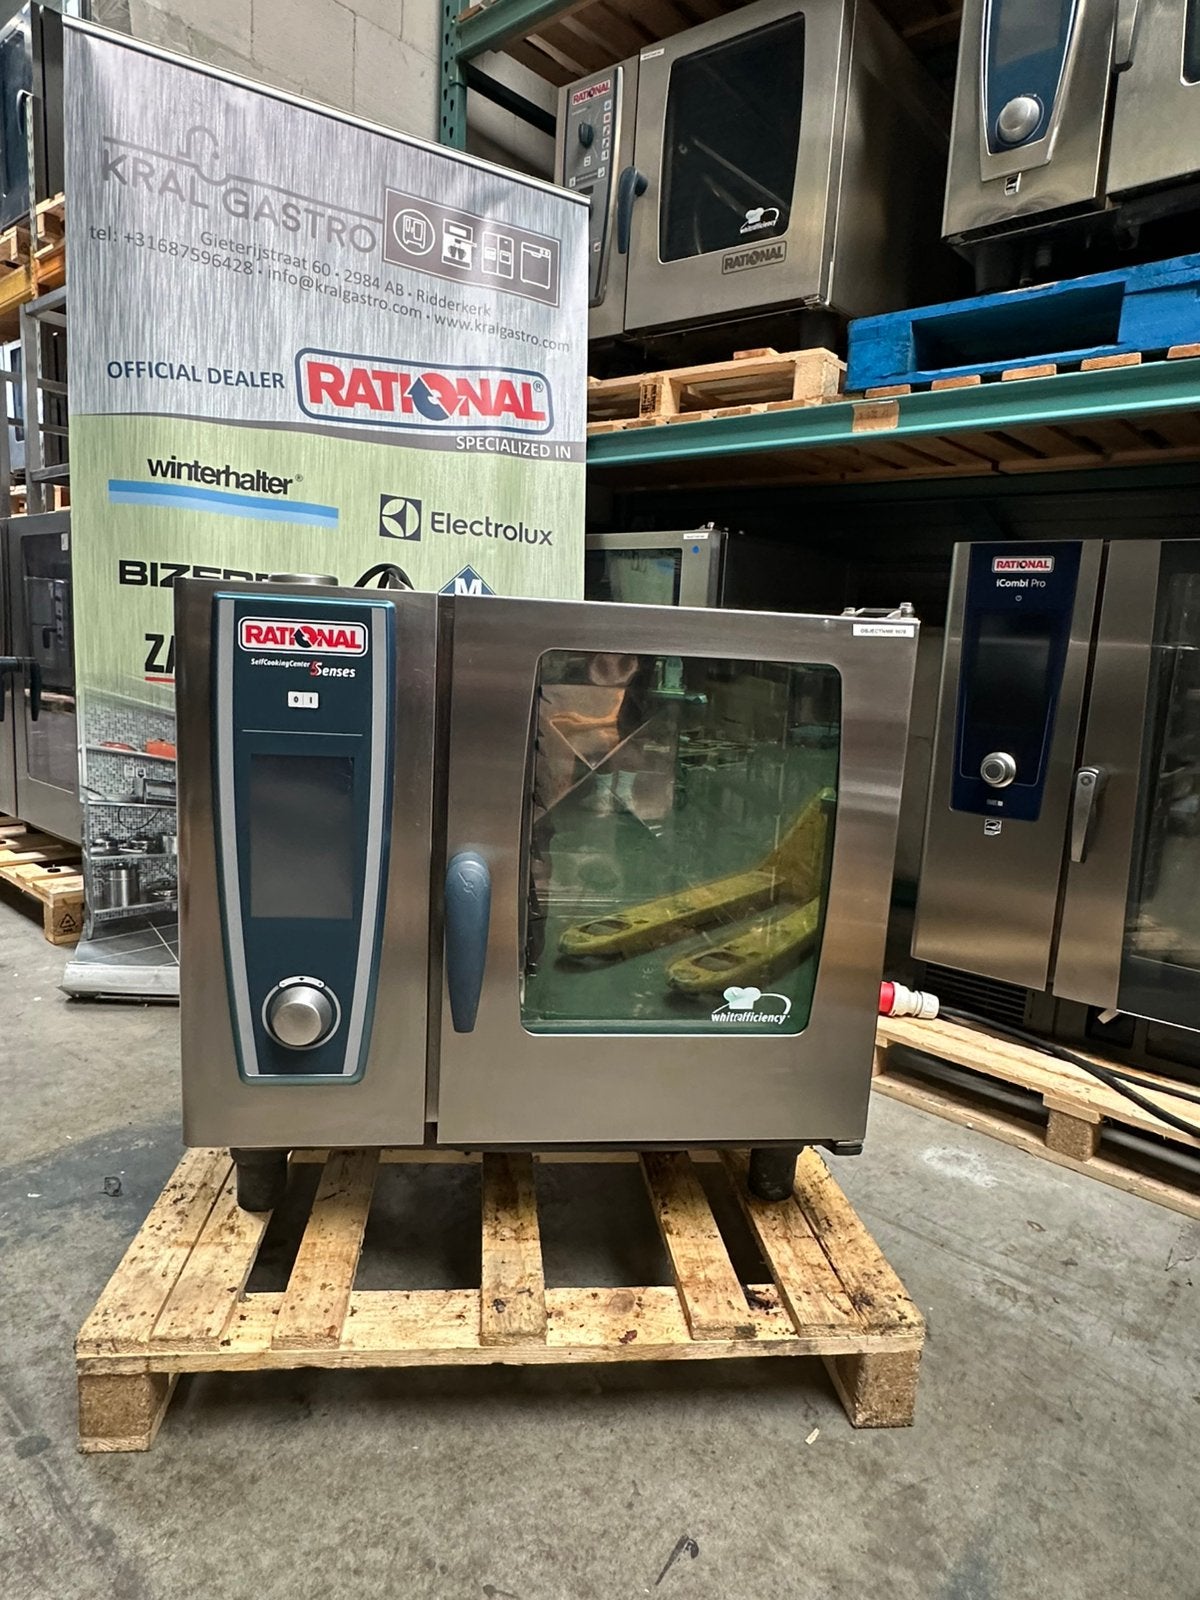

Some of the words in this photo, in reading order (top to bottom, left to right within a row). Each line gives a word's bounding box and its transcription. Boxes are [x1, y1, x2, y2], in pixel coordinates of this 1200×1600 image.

[103, 150, 209, 209] KRAL
[222, 188, 376, 253] GASTRO
[725, 246, 784, 271] RATIONAL
[200, 231, 308, 271] Gieterijstraat
[312, 262, 331, 277] 60
[344, 269, 380, 290] 2984
[384, 281, 404, 297] AB
[416, 289, 491, 317] Ridderkerk
[90, 224, 117, 243] tel:
[268, 265, 422, 320] info@kralgastro.com
[434, 312, 571, 353] www.kralgastro.com
[107, 361, 202, 382] OFFICIAL
[207, 367, 286, 389] DEALER
[456, 436, 550, 458] SPECIALIZED
[555, 442, 571, 459] IN
[431, 511, 553, 546] Electrolux
[996, 560, 1050, 569] RATIONAL
[996, 578, 1029, 588] iCombi
[1031, 578, 1046, 588] Pro
[245, 624, 362, 649] RATIONAL
[250, 658, 311, 668] SelfCookingCenter
